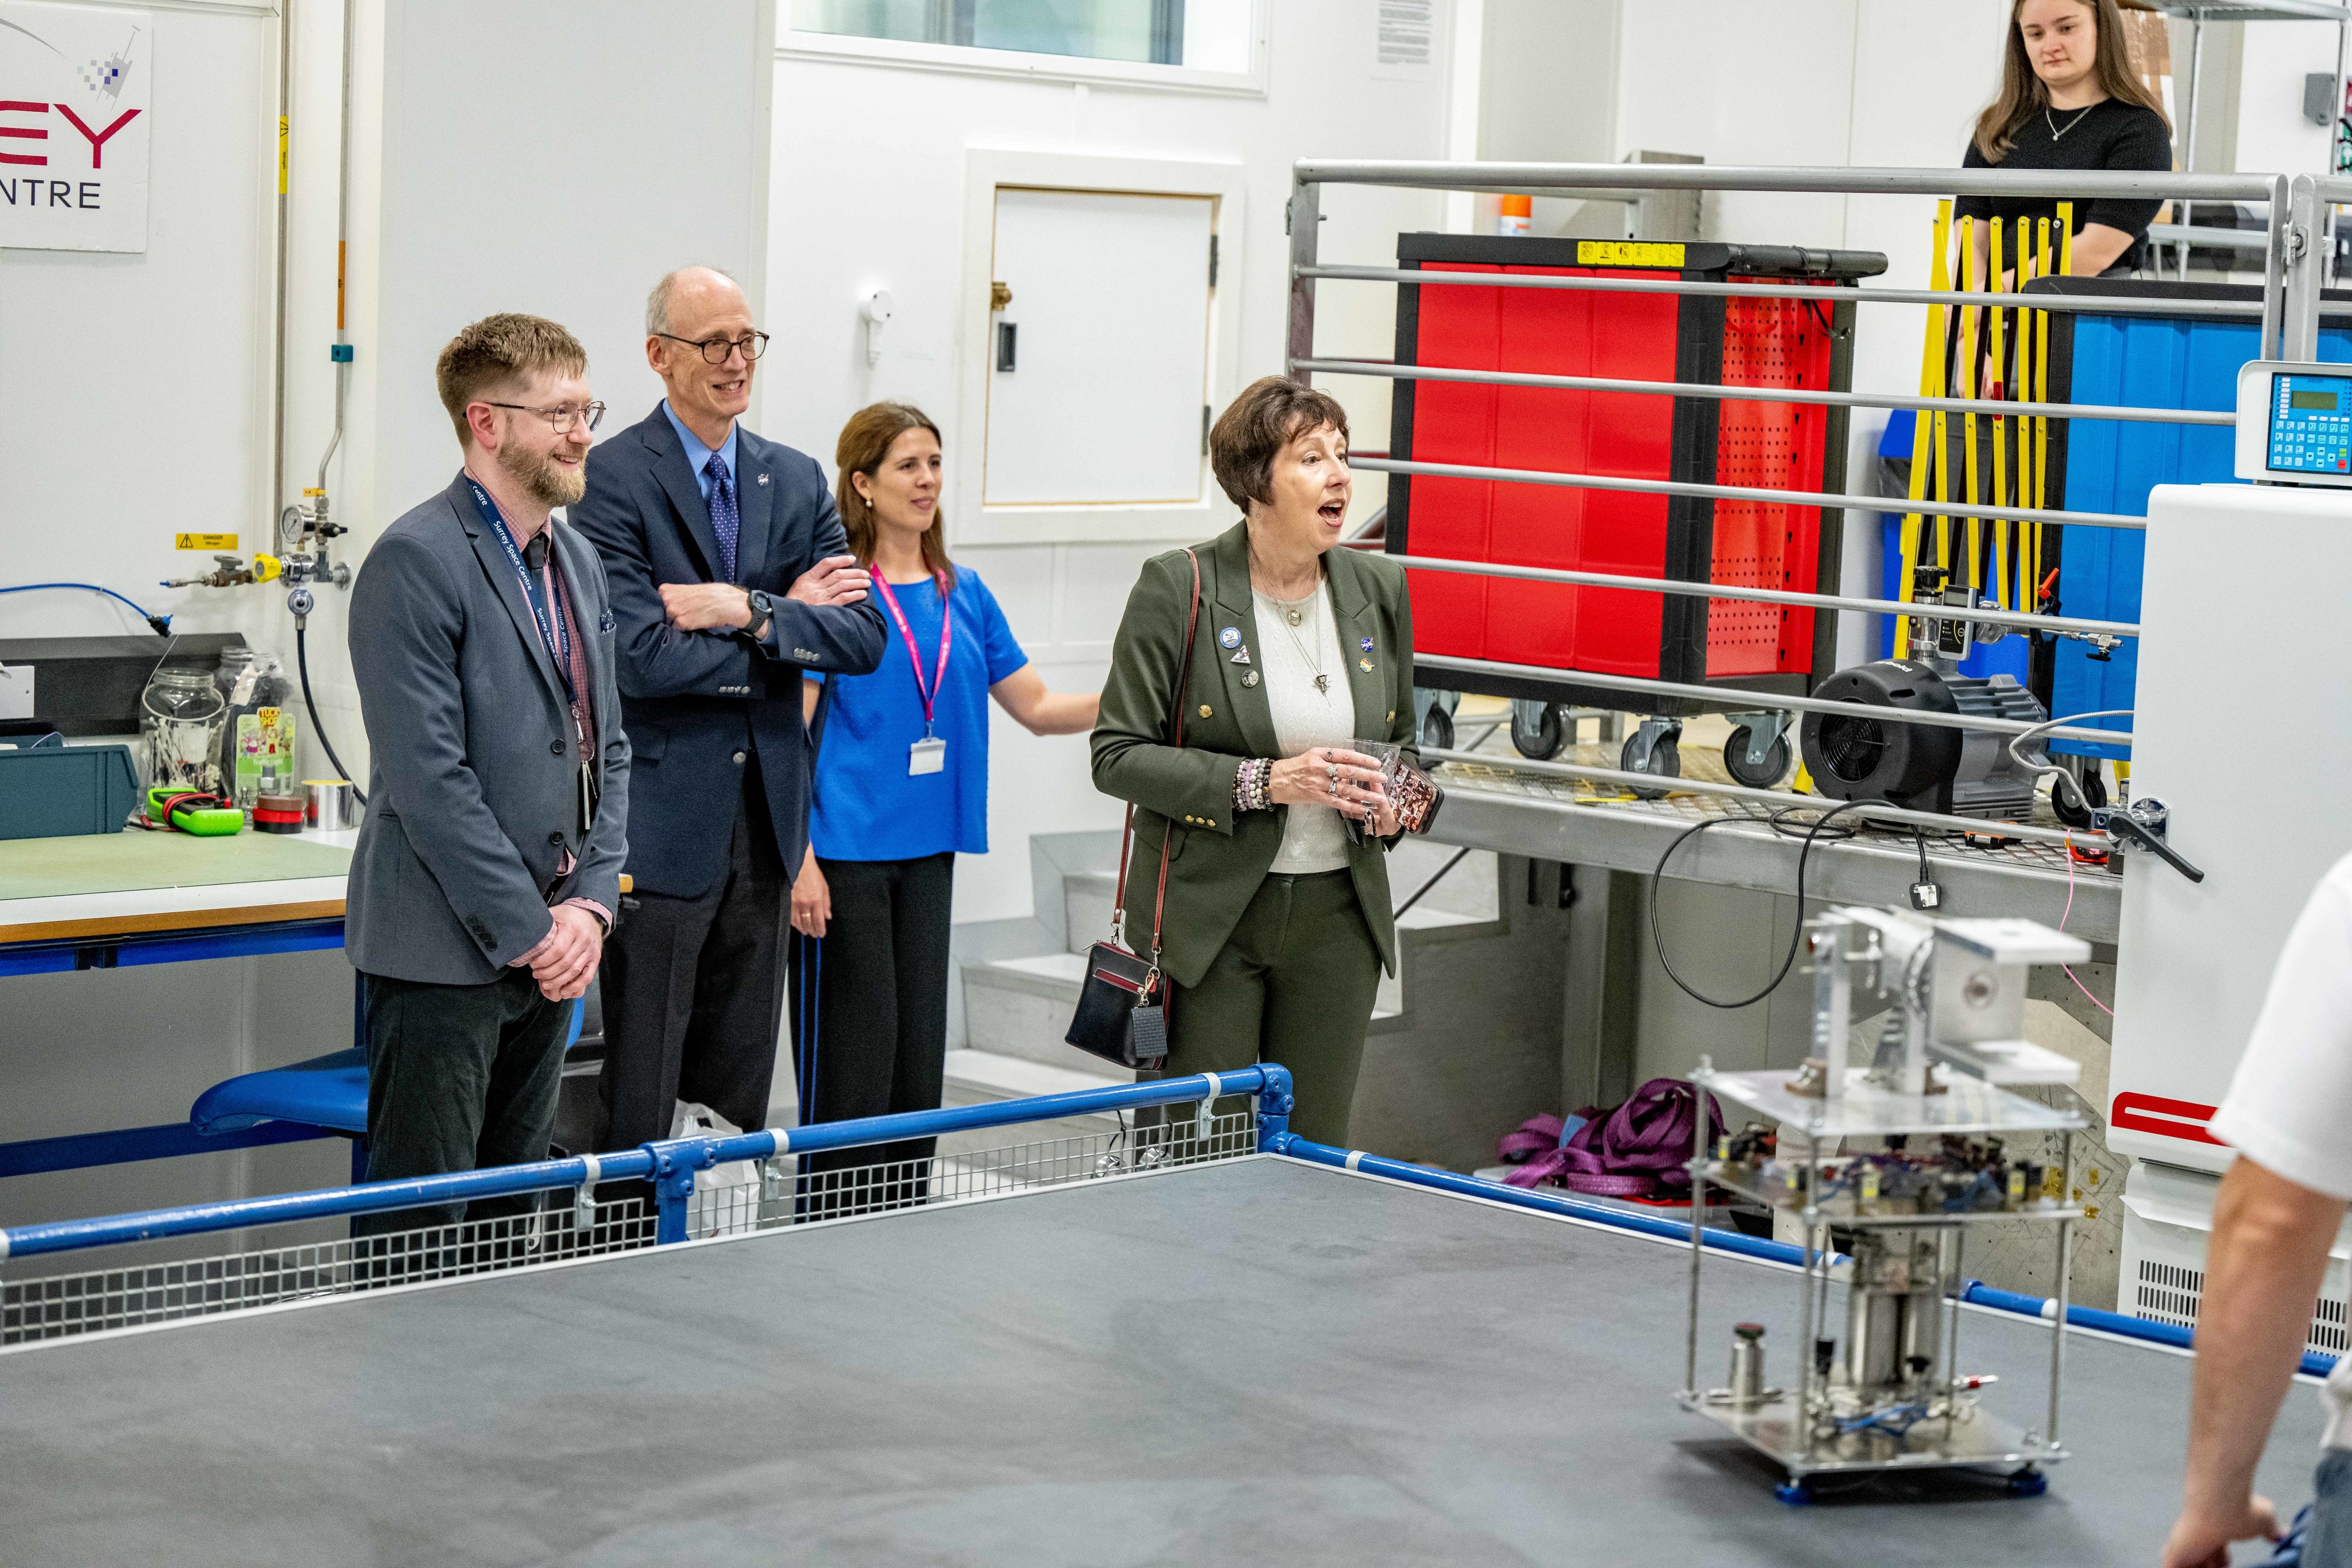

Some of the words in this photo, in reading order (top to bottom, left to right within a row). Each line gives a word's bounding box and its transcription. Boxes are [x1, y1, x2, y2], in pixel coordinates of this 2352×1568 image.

[494, 520, 509, 544] Surrey
[506, 544, 520, 566] Space
[519, 566, 532, 591] Centre
[537, 607, 548, 631] Surrey
[546, 633, 555, 653] Space
[557, 606, 565, 630] Centre
